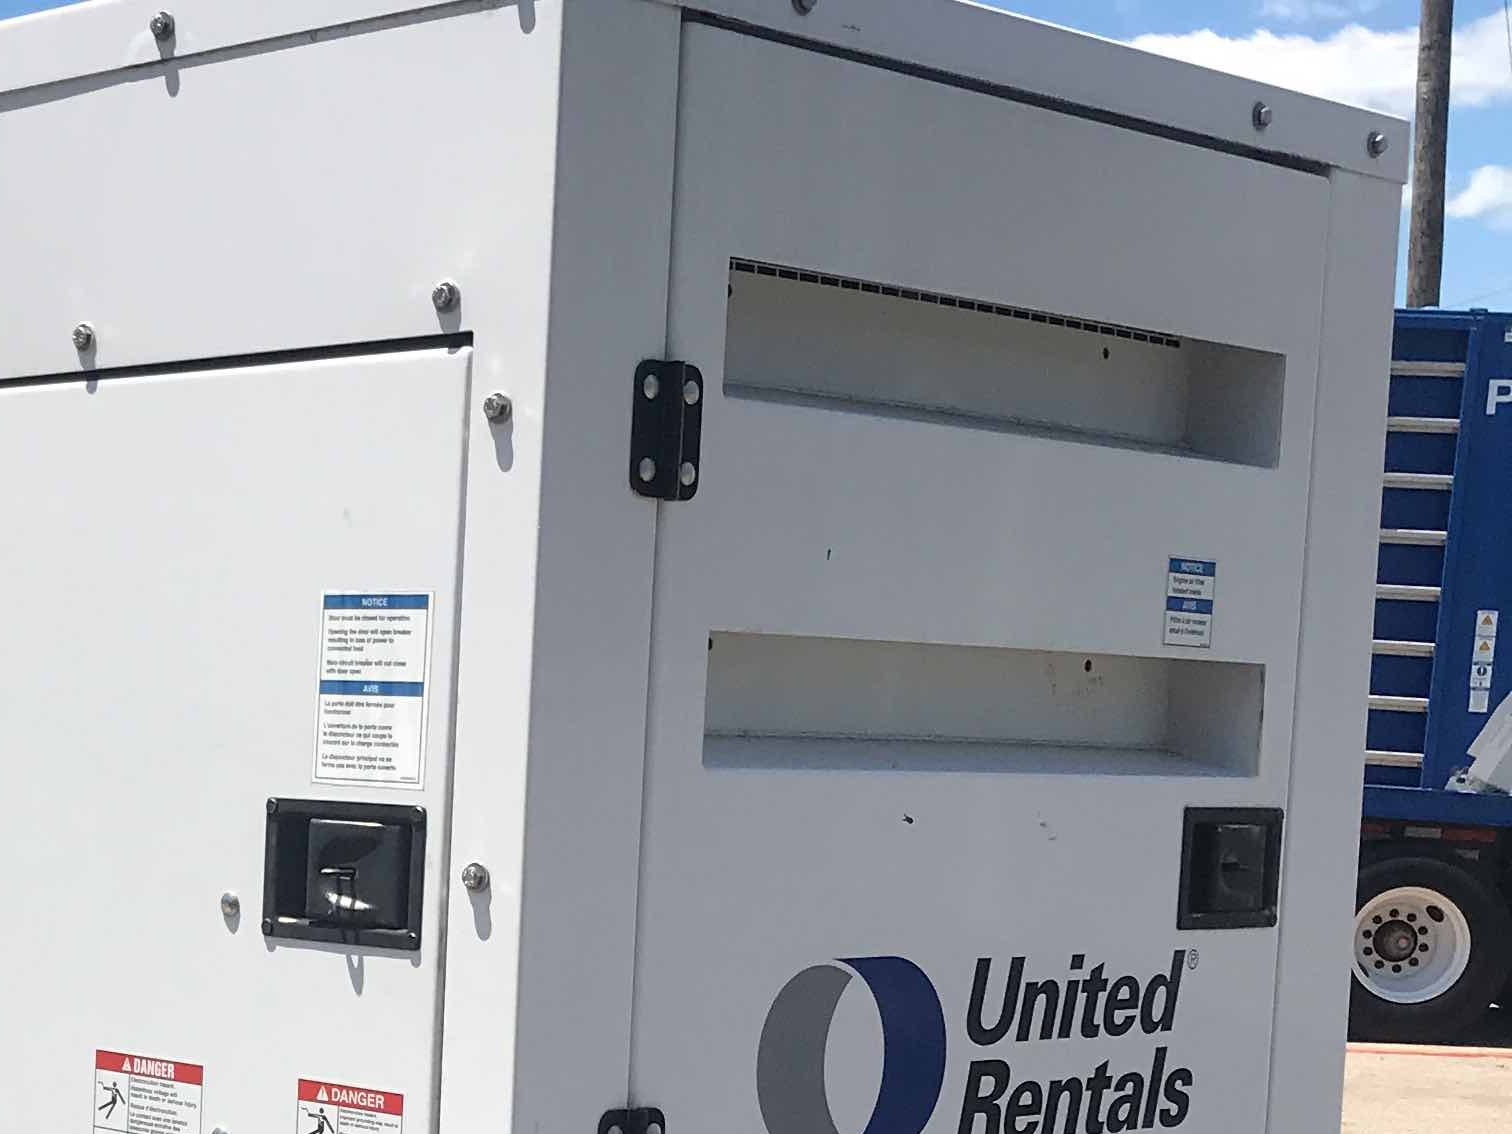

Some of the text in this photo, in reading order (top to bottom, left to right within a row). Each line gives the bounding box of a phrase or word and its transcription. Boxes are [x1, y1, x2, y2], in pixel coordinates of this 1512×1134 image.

[361, 598, 388, 607] NOTICE
[965, 949, 1186, 1046] United
[133, 1057, 175, 1080] DANGER
[331, 1087, 385, 1109] DANGER
